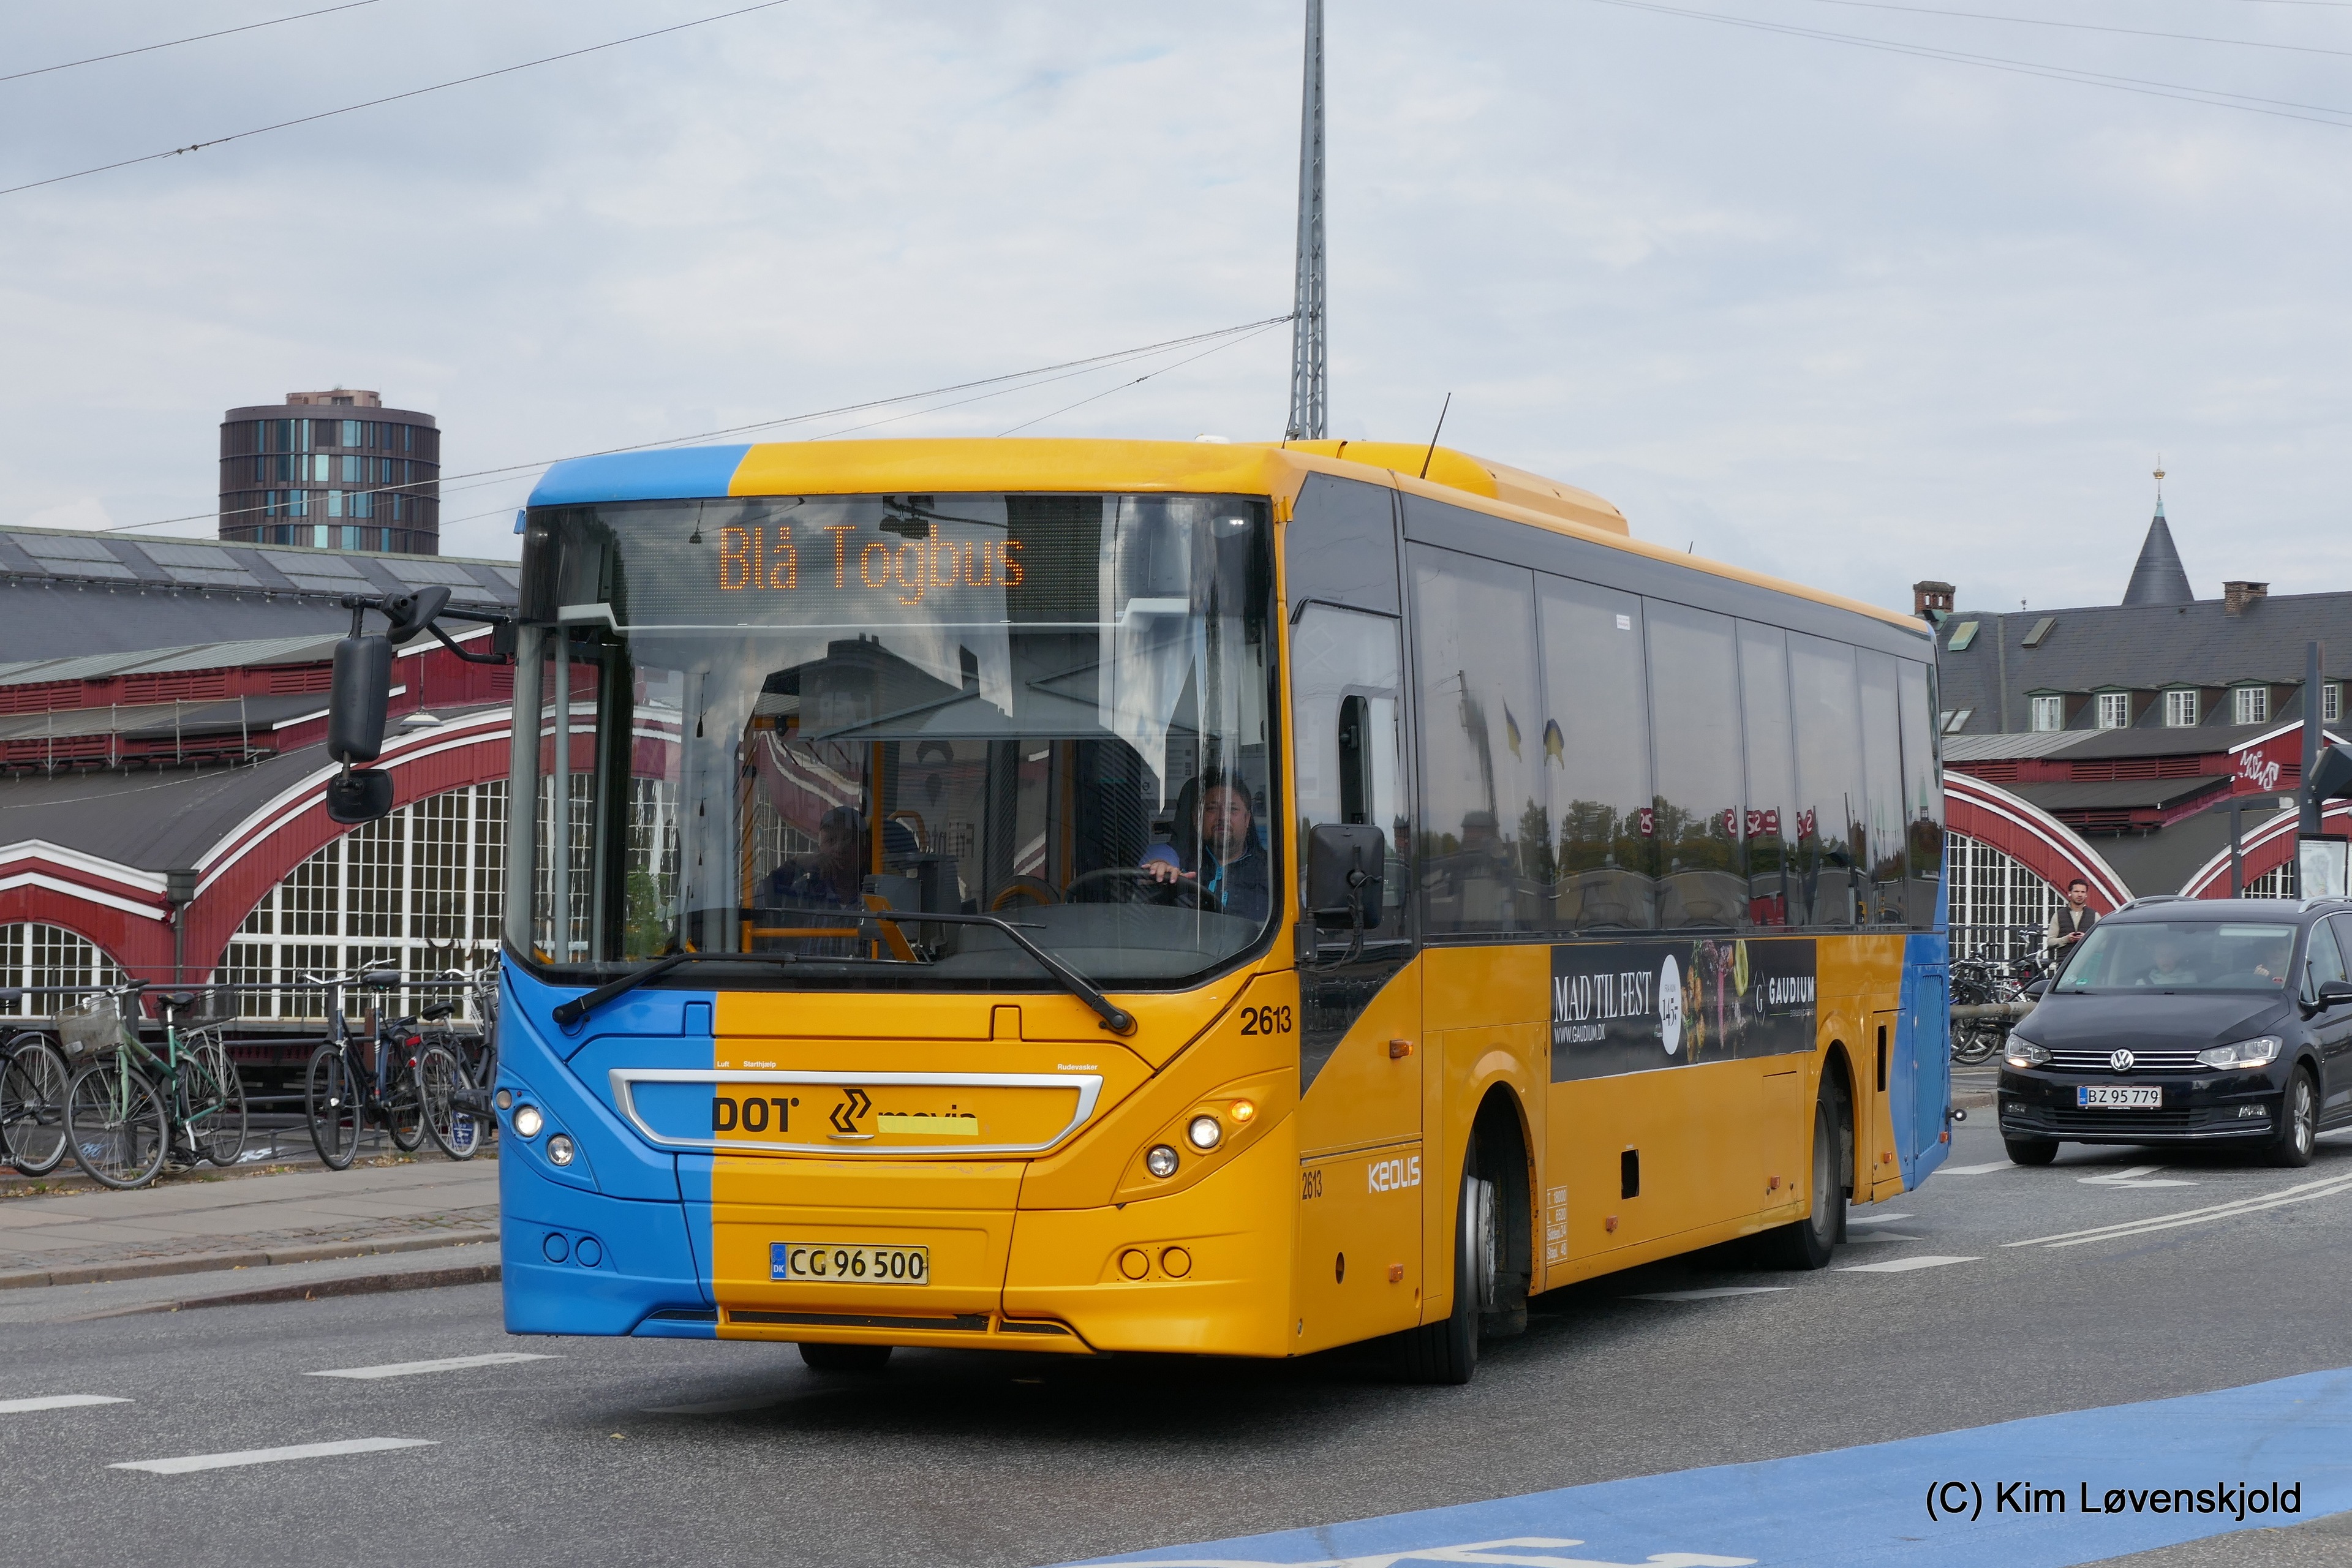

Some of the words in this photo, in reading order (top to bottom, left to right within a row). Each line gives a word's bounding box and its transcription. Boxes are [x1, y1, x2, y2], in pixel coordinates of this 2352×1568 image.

[720, 526, 796, 589] Blå
[824, 524, 1024, 605] Togbus
[1554, 975, 1591, 1022] MAD
[1594, 973, 1618, 1019] TIL
[1620, 970, 1652, 1017] FEST
[1769, 976, 1814, 1005] GAUDIUM
[1240, 1005, 1292, 1036] 2613
[1555, 1023, 1606, 1044] WWW.GAUDIUM.DK
[743, 1060, 776, 1069] Starthjælp
[2089, 1090, 2107, 1103] BZ
[2111, 1090, 2128, 1103] 95
[2132, 1090, 2158, 1103] 779
[712, 1097, 791, 1133] DOT
[1302, 1170, 1322, 1200] 2613
[773, 1264, 785, 1273] DK
[790, 1249, 826, 1276] CG
[834, 1249, 866, 1277] 96
[873, 1251, 924, 1280] 500
